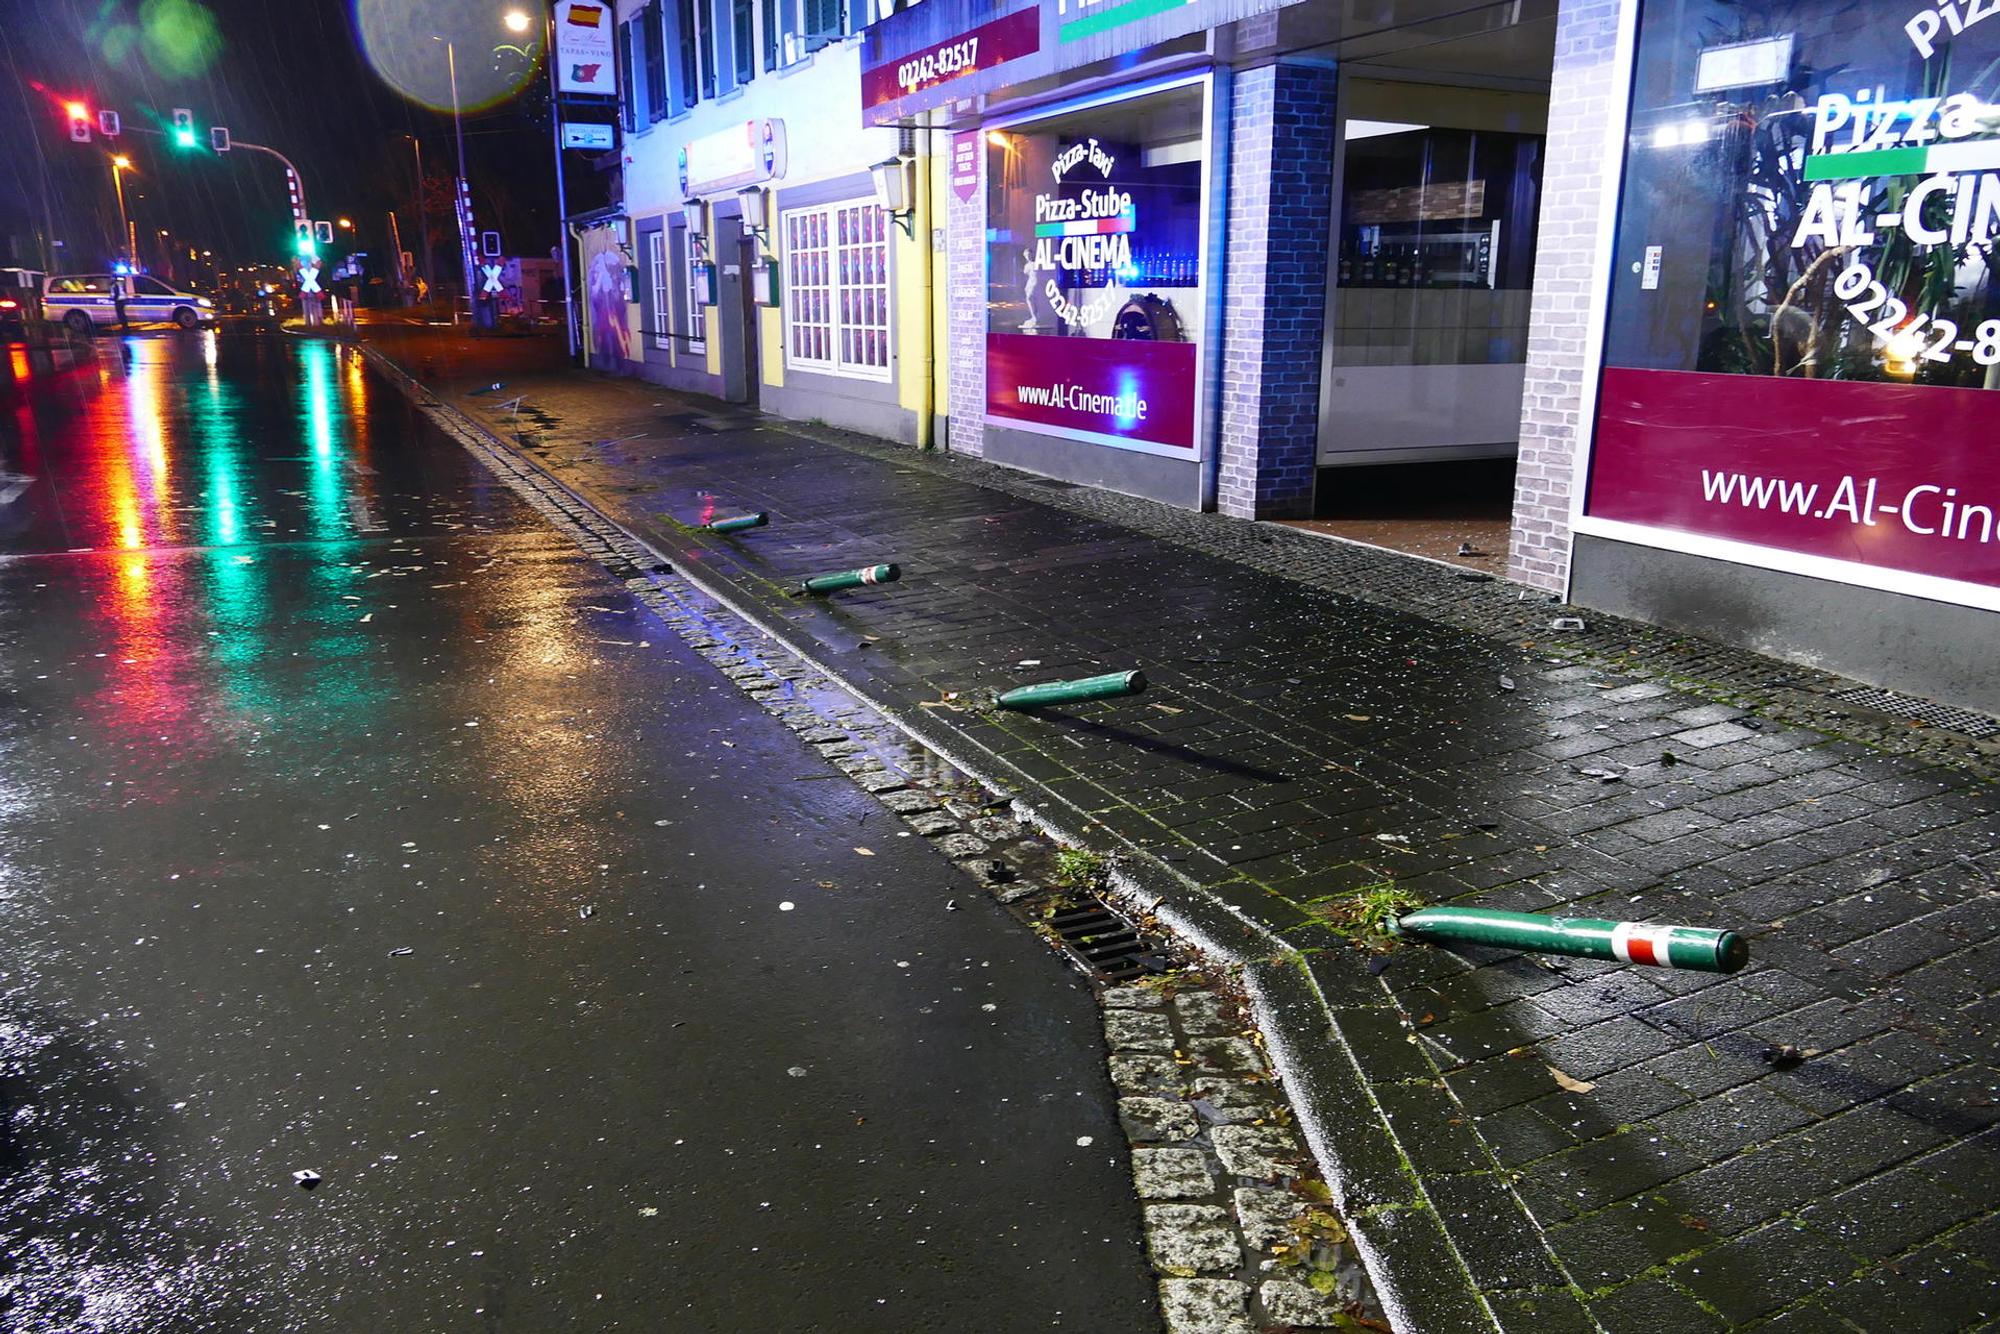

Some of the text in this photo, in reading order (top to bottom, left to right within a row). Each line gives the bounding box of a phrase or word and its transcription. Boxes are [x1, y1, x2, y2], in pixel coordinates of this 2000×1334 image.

[1904, 0, 2000, 59] Piz
[898, 37, 978, 88] 02242-82517
[1051, 138, 1115, 184] Pizza-Taxi
[1035, 186, 1131, 222] Pizza-Stube
[1034, 234, 1132, 270] AL-CINEMA
[1017, 384, 1148, 419] www.Al-Cinema.de
[1702, 469, 2000, 543] www.Al-Cin
